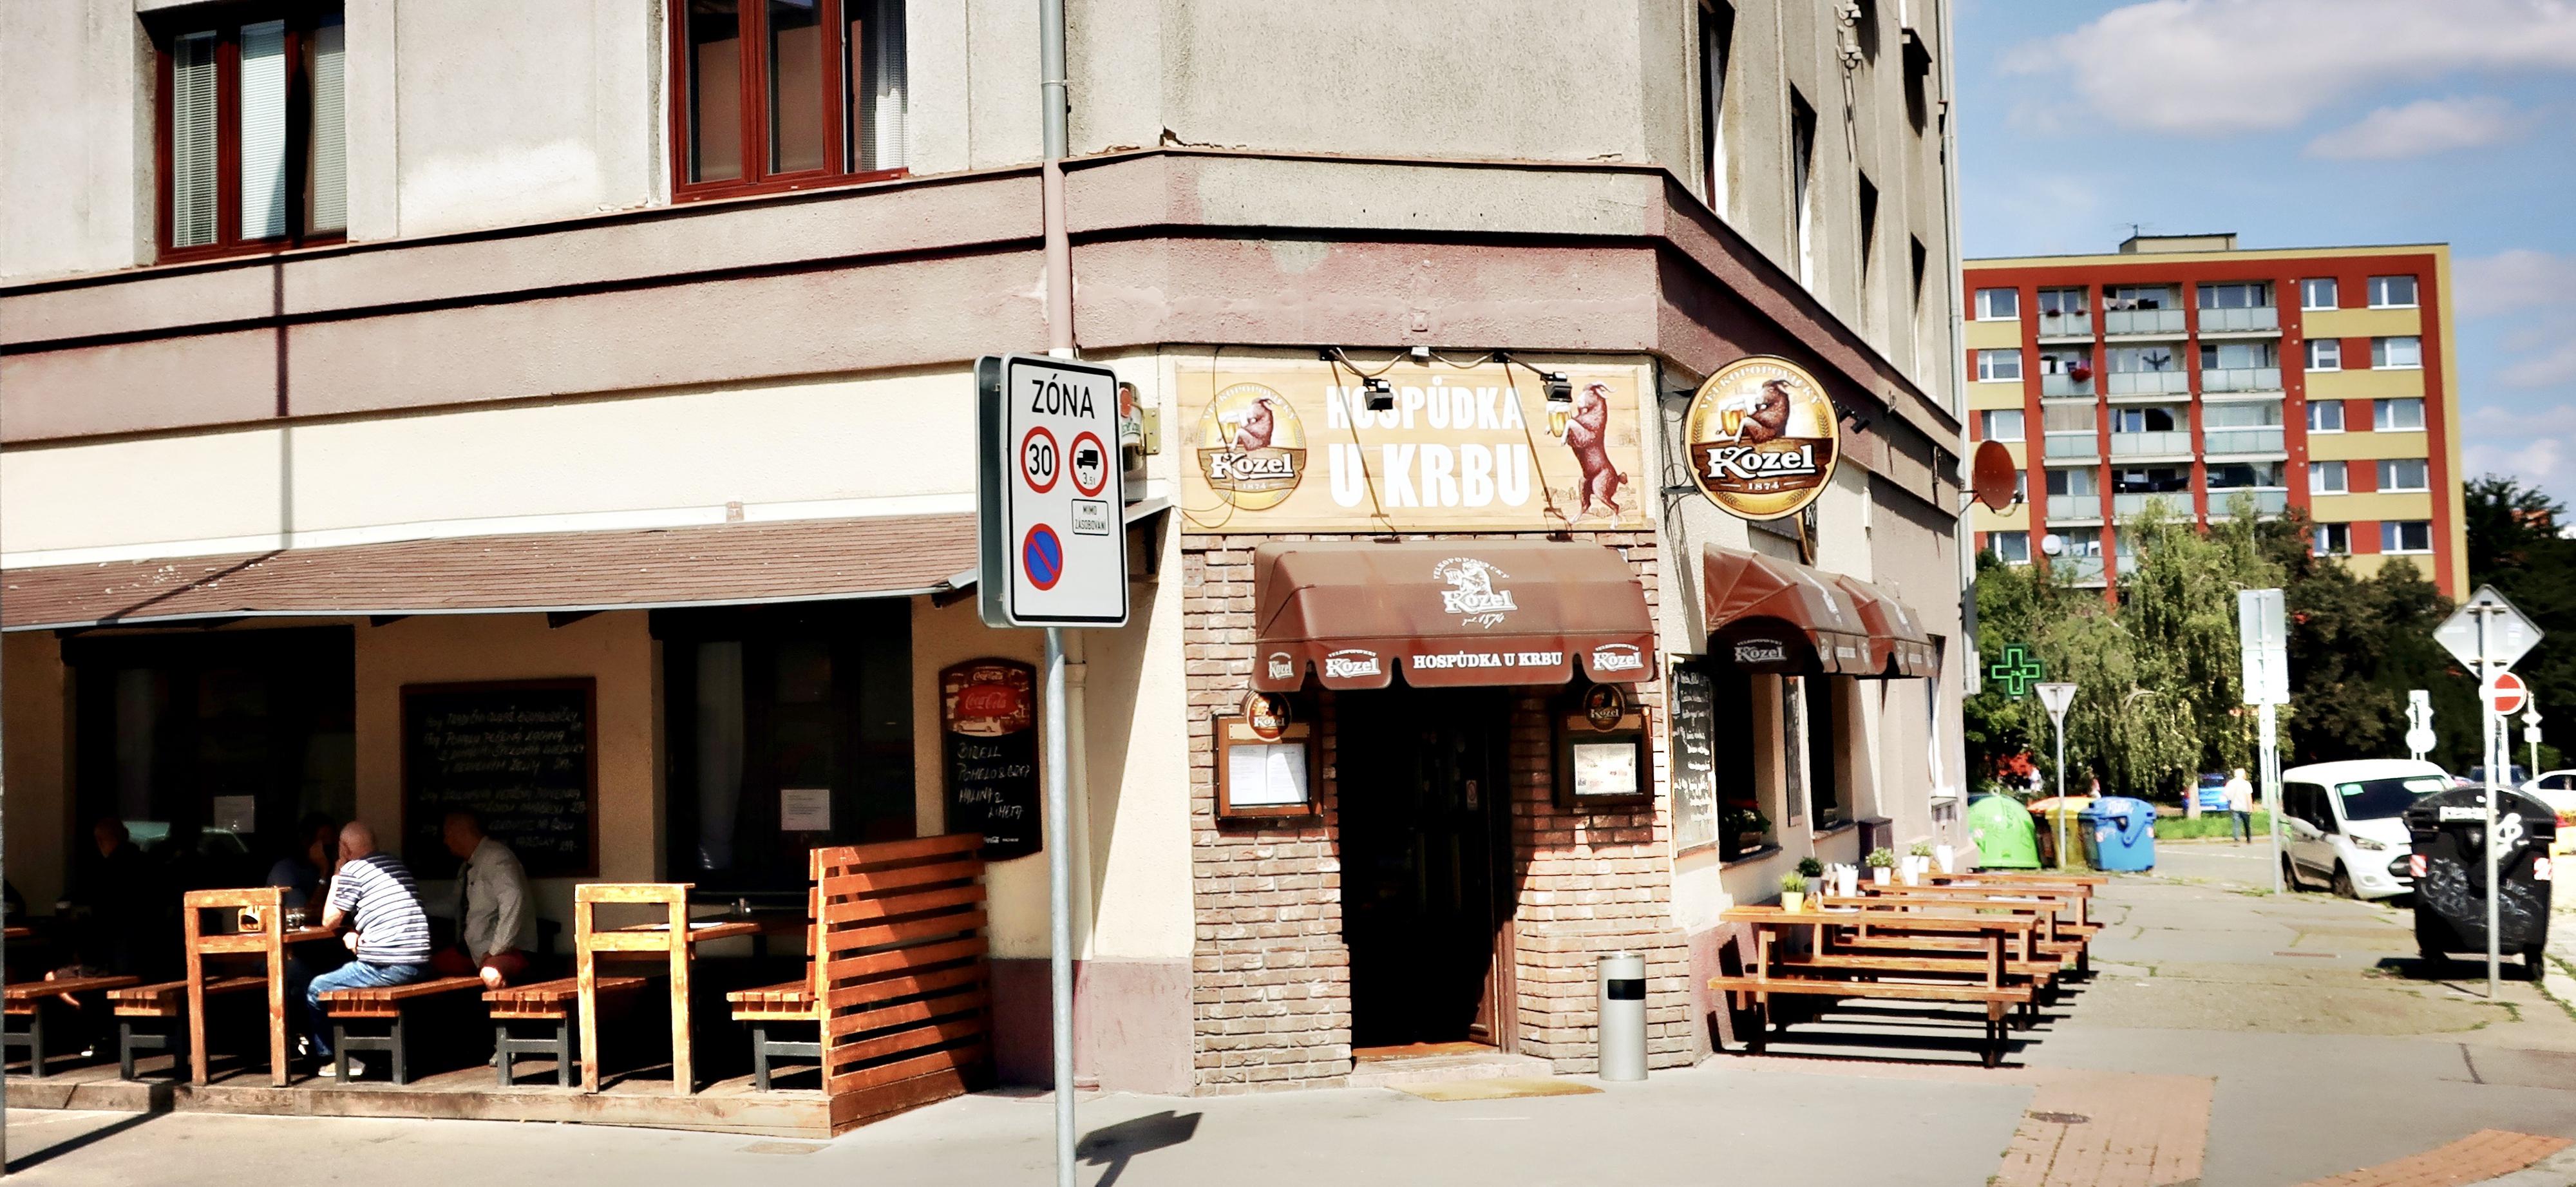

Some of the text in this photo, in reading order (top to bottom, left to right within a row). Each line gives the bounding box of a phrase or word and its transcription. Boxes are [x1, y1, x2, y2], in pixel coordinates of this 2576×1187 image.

[1031, 373, 1095, 419] ZÓNA
[1325, 376, 1524, 430] HOSPŮDKA
[1028, 443, 1052, 477] 30
[1209, 452, 1295, 480] Kozel
[1706, 444, 1816, 479] Kozel
[1329, 443, 1531, 508] U KRBU
[1747, 481, 1780, 491] 1874
[1440, 589, 1519, 614] Kozel
[1412, 650, 1563, 669] HOSPŮDKA U KRBU
[1592, 651, 1645, 672] Kozel
[1733, 646, 1788, 663] Kozel
[1267, 660, 1294, 680] Kozel
[1325, 657, 1382, 678] Kozel
[1589, 708, 1620, 719] Kozel
